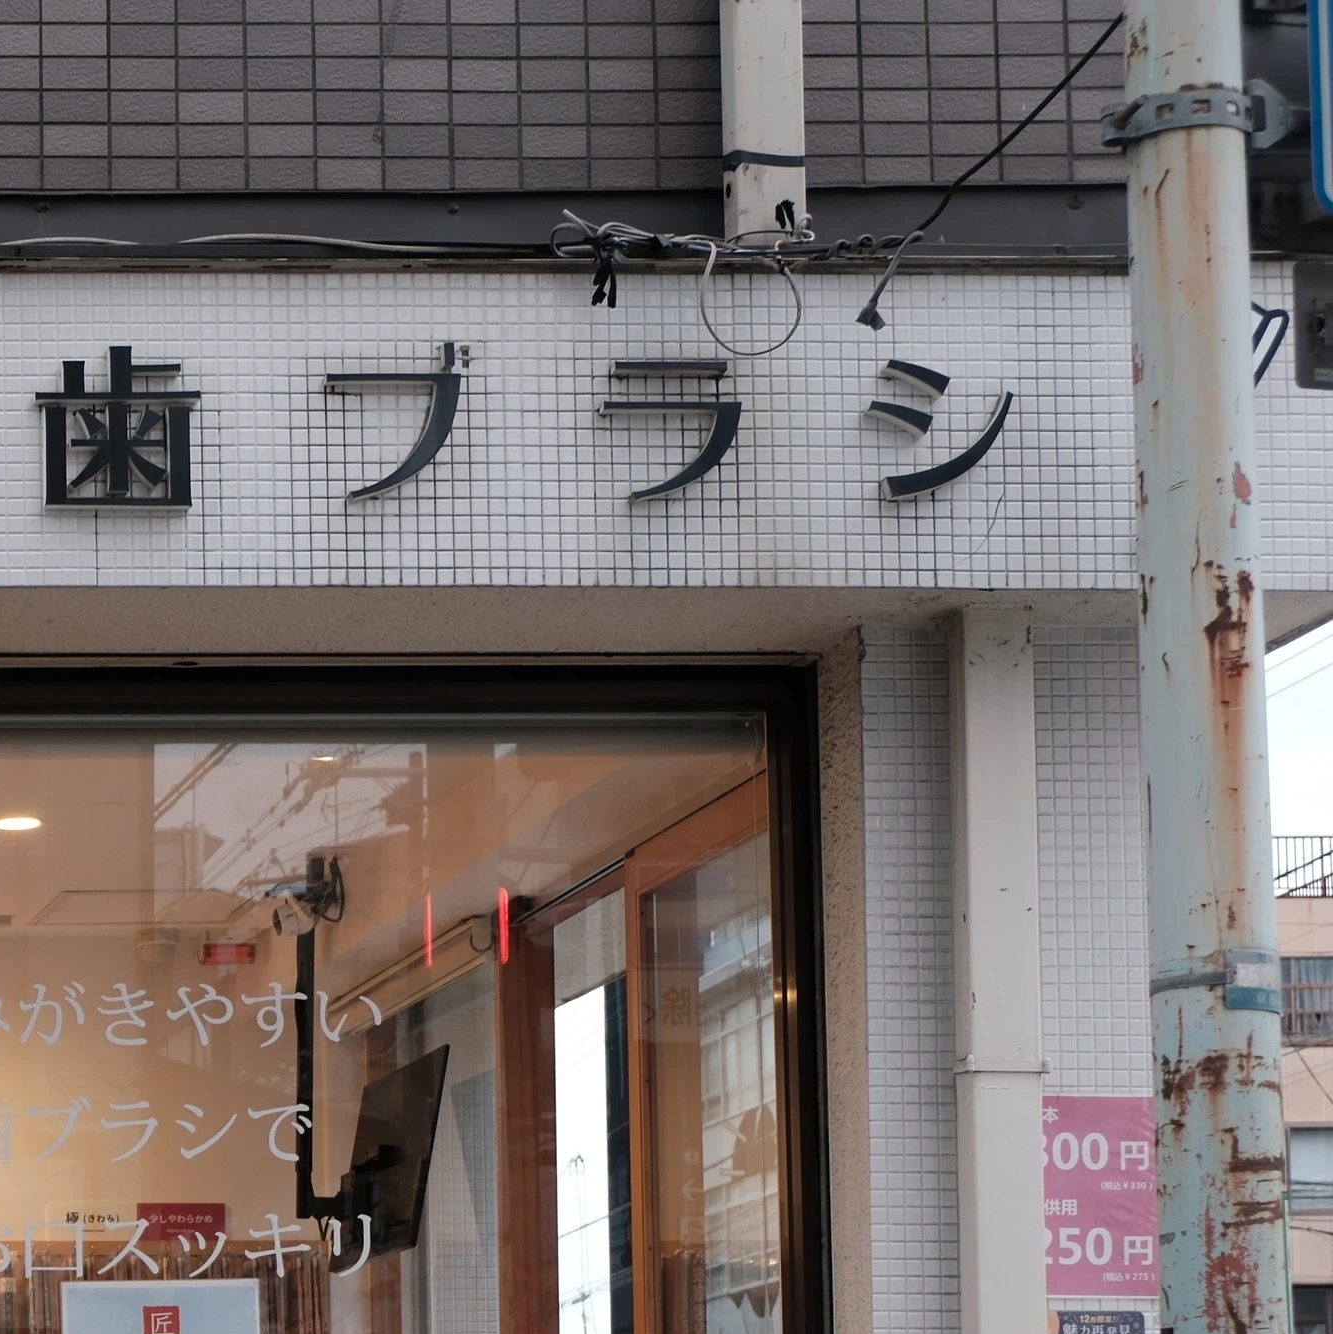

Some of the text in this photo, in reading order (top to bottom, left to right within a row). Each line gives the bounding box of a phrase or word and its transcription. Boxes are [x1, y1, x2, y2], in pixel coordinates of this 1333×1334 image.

[1041, 1131, 1150, 1171] 00円
[149, 1214, 213, 1224] 少しやわらかめ
